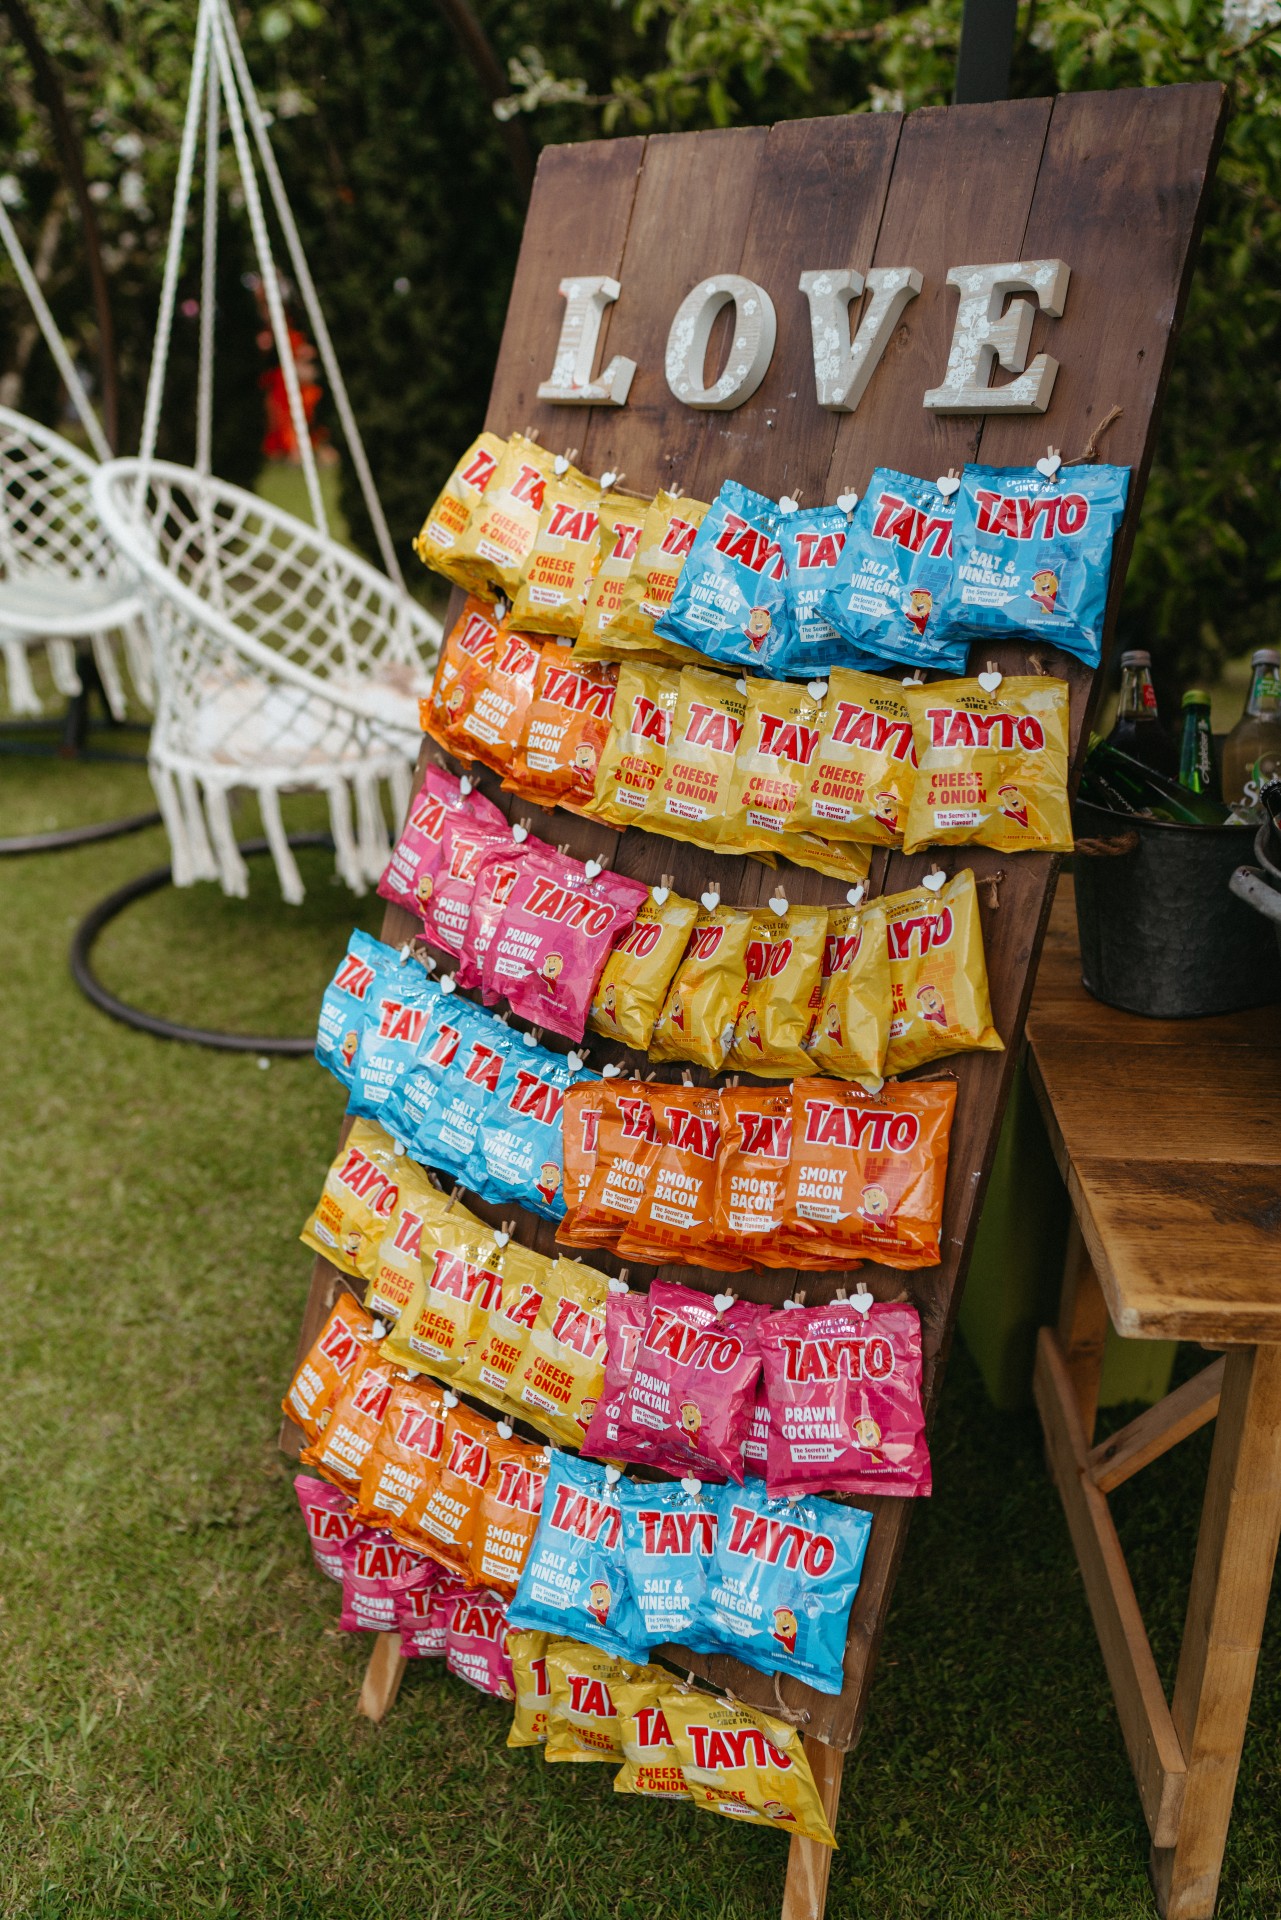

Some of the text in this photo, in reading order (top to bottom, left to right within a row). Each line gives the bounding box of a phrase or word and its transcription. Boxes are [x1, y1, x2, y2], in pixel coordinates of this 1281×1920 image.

[536, 258, 1071, 415] LOVE
[490, 512, 530, 541] CHEESE
[546, 503, 600, 543] TAY
[872, 493, 953, 559] TAYT
[975, 489, 1090, 540] TAYTO
[480, 522, 489, 534] &
[489, 526, 524, 555] ONION
[715, 513, 789, 581] TAYT
[535, 556, 576, 574] CHEESE
[862, 558, 899, 581] SALT &
[970, 549, 1016, 573] SALT &
[528, 567, 574, 589] & ONION
[703, 571, 739, 597] SALT &
[851, 573, 900, 598] VINEGAR
[959, 566, 1021, 587] VINEGAR
[690, 584, 740, 615] VINEGAR
[481, 688, 517, 715] SMOKY
[541, 666, 616, 721] TAYT
[474, 700, 508, 729] BACON
[530, 720, 568, 738] SMOKY
[685, 702, 744, 755] TAY
[759, 712, 819, 767] TAY
[832, 701, 918, 769] TAYT
[926, 708, 1046, 753] TAYTO
[528, 734, 560, 753] BACON
[614, 769, 656, 790] & ONIO
[672, 764, 719, 787] CHEESE
[749, 776, 798, 798] CHEESE
[818, 764, 866, 786] CHEESE
[932, 772, 983, 788] CHEESE
[664, 778, 718, 804] & ONION
[741, 792, 797, 814] & ONION
[810, 779, 865, 803] & ONION
[927, 789, 987, 806] & ONION
[678, 803, 697, 813] Secret's
[679, 808, 699, 820] Flavour!
[759, 815, 778, 825] Secret's
[825, 804, 843, 814] Secret's
[826, 811, 846, 821] Flavour!
[949, 812, 969, 820] Secret's
[951, 819, 974, 827] Flavour!
[522, 875, 617, 938] TAYTO
[505, 927, 543, 949] PRAWN
[497, 940, 537, 962] COCKTAIL
[378, 999, 430, 1044] TAY
[368, 1056, 394, 1072] SALT
[450, 1098, 475, 1120] SALT
[508, 1068, 564, 1126] TAY
[442, 1107, 479, 1137] VINEGA
[664, 1107, 720, 1161] TAY
[805, 1099, 920, 1153] TAYTO
[495, 1129, 532, 1154] SALT &
[737, 1111, 793, 1159] TAY
[483, 1138, 532, 1171] VINEGAR
[611, 1157, 650, 1178] SMOKY
[800, 1166, 847, 1184] SMOKY
[606, 1171, 645, 1194] BACON
[658, 1169, 703, 1193] SMOKY
[730, 1176, 779, 1195] SMOKY
[797, 1183, 843, 1201] BACON
[653, 1185, 698, 1209] BACON
[730, 1192, 775, 1211] BACON
[799, 1203, 831, 1214] The Secret's
[811, 1211, 833, 1220] Flavour!
[380, 1266, 415, 1294] CHEESE
[381, 1283, 410, 1307] ONION
[421, 1311, 456, 1333] HEESE
[553, 1296, 606, 1359] TAY
[419, 1325, 454, 1349] ONION
[644, 1305, 743, 1374] TAYTO
[480, 1349, 489, 1361] &
[778, 1336, 895, 1384] TAYTO
[534, 1357, 575, 1388] CHEESE
[634, 1371, 670, 1397] PRAWN
[524, 1368, 571, 1404] & ONION
[785, 1407, 836, 1422] PRAWN
[335, 1424, 373, 1454] SMOKY
[782, 1424, 843, 1440] COCKTAIL
[329, 1437, 364, 1466] BACON
[383, 1463, 422, 1489] SMOKY
[495, 1461, 548, 1516] TAY
[380, 1477, 415, 1503] BACON
[426, 1500, 462, 1530] BACON
[432, 1490, 470, 1518] SMOKY
[549, 1482, 623, 1550] TAYT
[307, 1505, 361, 1541] TAY
[637, 1510, 718, 1556] TAYT
[487, 1524, 528, 1549] SMOKY
[727, 1504, 836, 1578] TAYTO
[484, 1540, 522, 1563] BACON
[540, 1550, 578, 1575] SALT &
[531, 1562, 580, 1594] VINEGAR
[644, 1579, 683, 1594] SALT &
[722, 1576, 759, 1601] SALT &
[638, 1595, 690, 1610] VINEGAR
[712, 1587, 762, 1620] VINEGAR
[636, 1777, 689, 1791] & ONION
[639, 1768, 684, 1780] CHEESE
